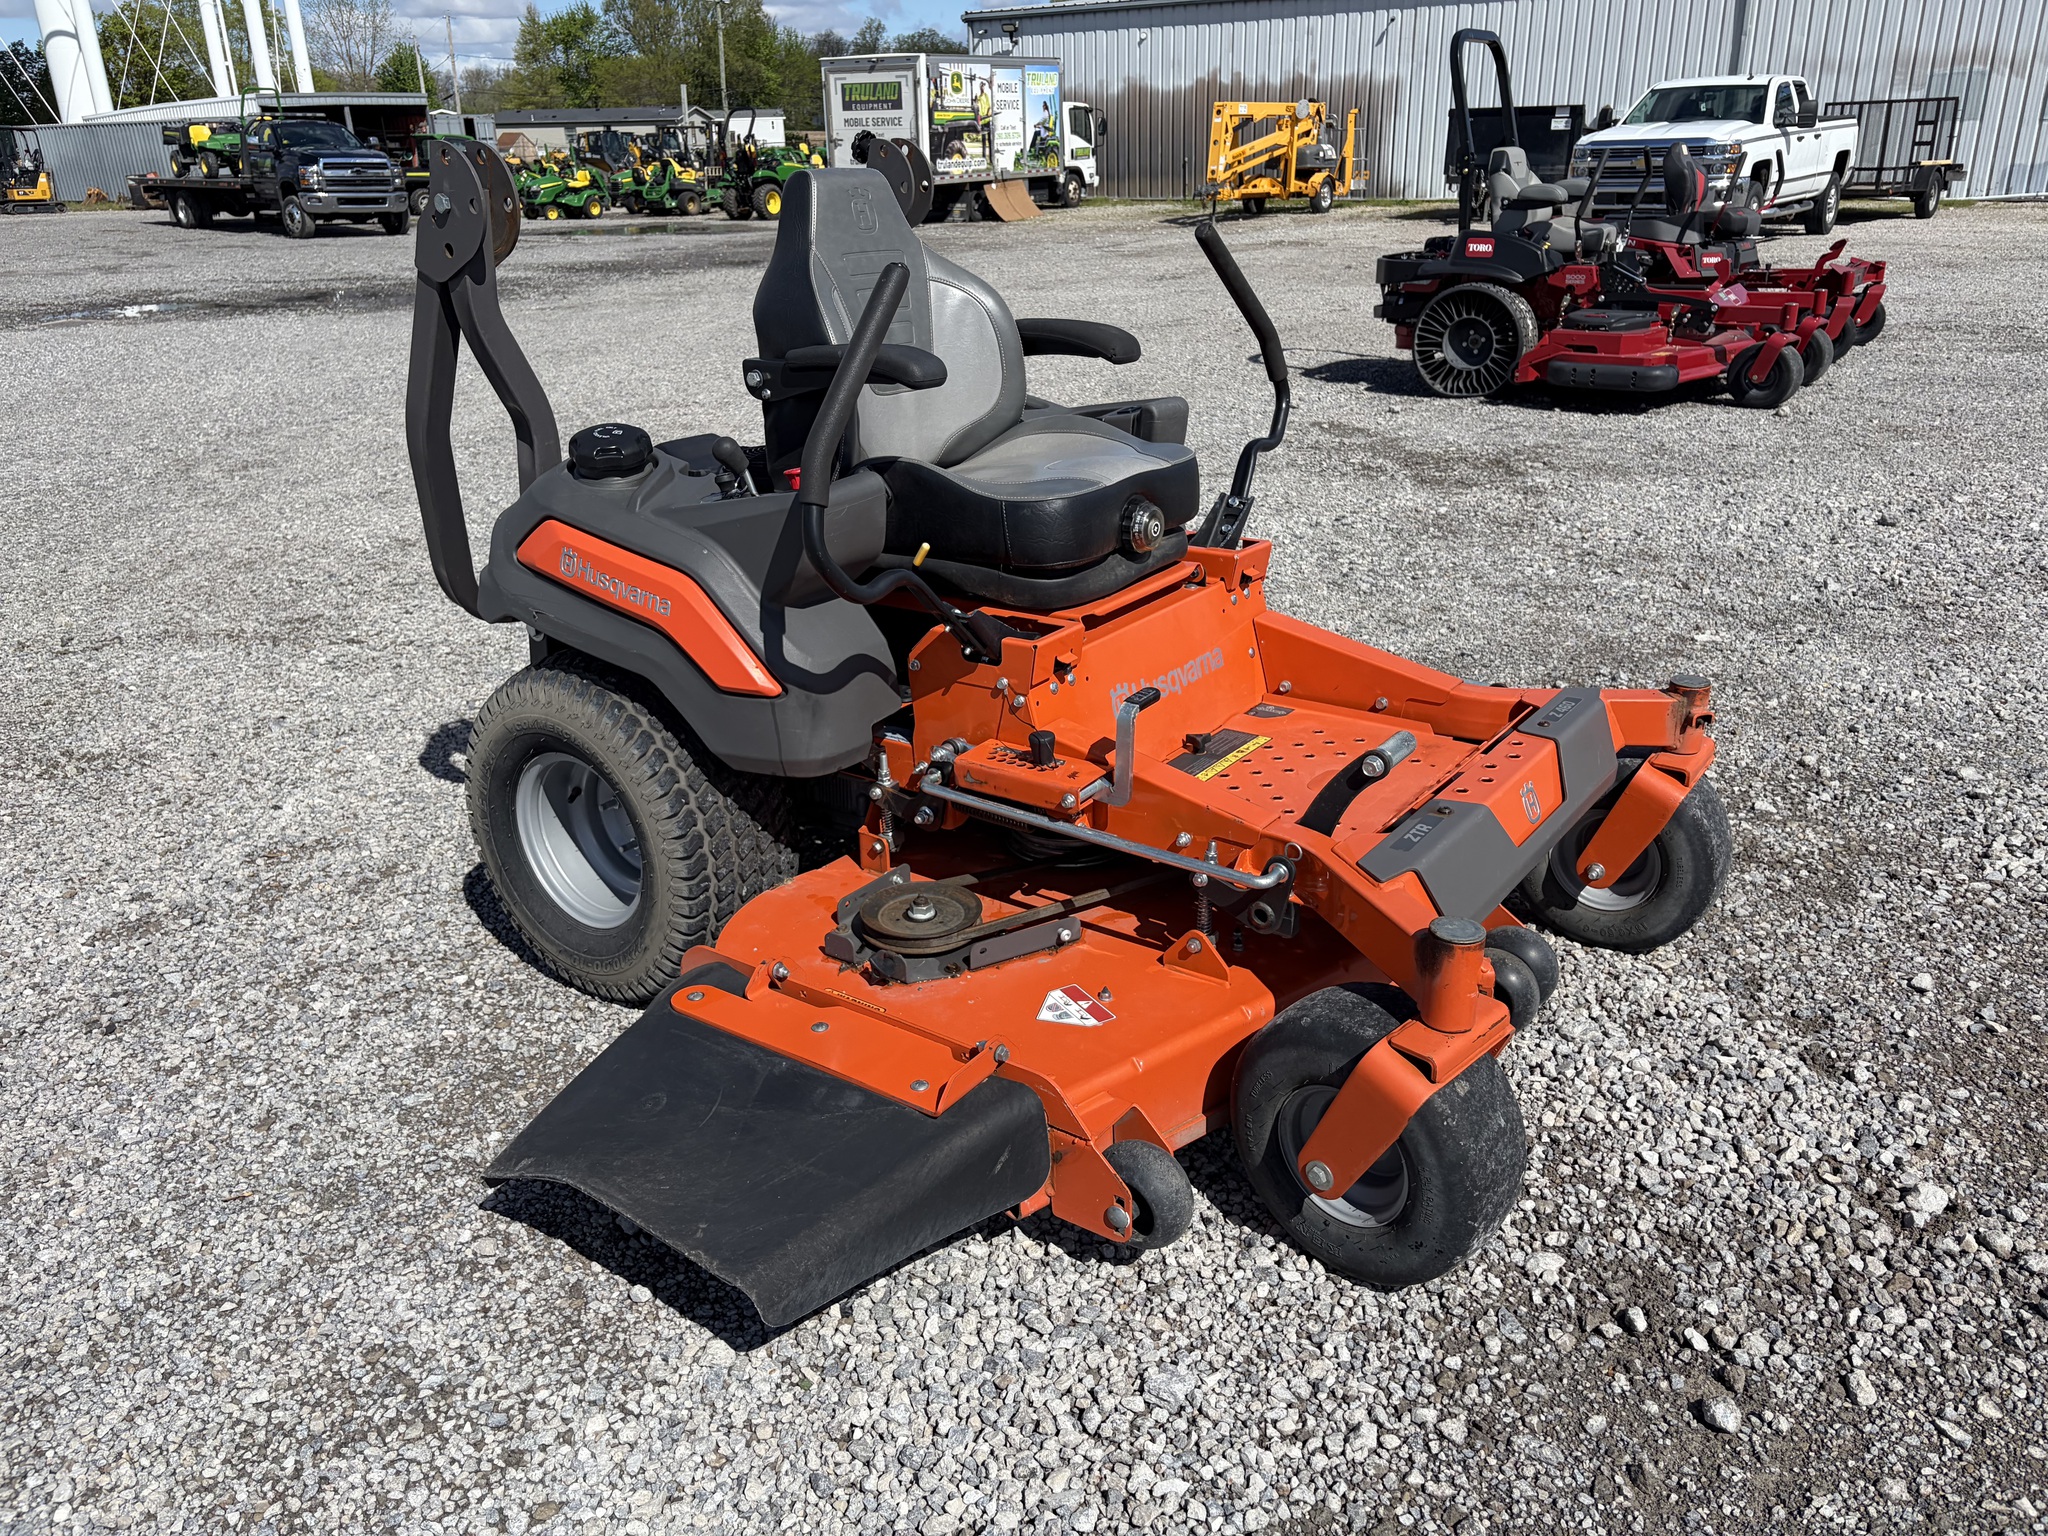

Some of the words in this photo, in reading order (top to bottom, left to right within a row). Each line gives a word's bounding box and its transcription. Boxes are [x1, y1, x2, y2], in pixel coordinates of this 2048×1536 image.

[1027, 73, 1058, 86] TRULAND
[843, 82, 899, 101] TRULAND
[997, 83, 1018, 93] MOBILE
[996, 100, 1020, 110] SERVICE
[844, 118, 870, 128] MOBILE
[872, 117, 903, 127] SERVICE
[937, 161, 986, 170] trulandequip.com
[1468, 243, 1493, 252] TORO
[577, 558, 671, 617] Husqvarna
[1131, 648, 1224, 697] sqvarna
[514, 719, 591, 754] COMMERCIAL
[1403, 822, 1433, 843] ZTR
[1250, 1069, 1273, 1098] TUBELESS
